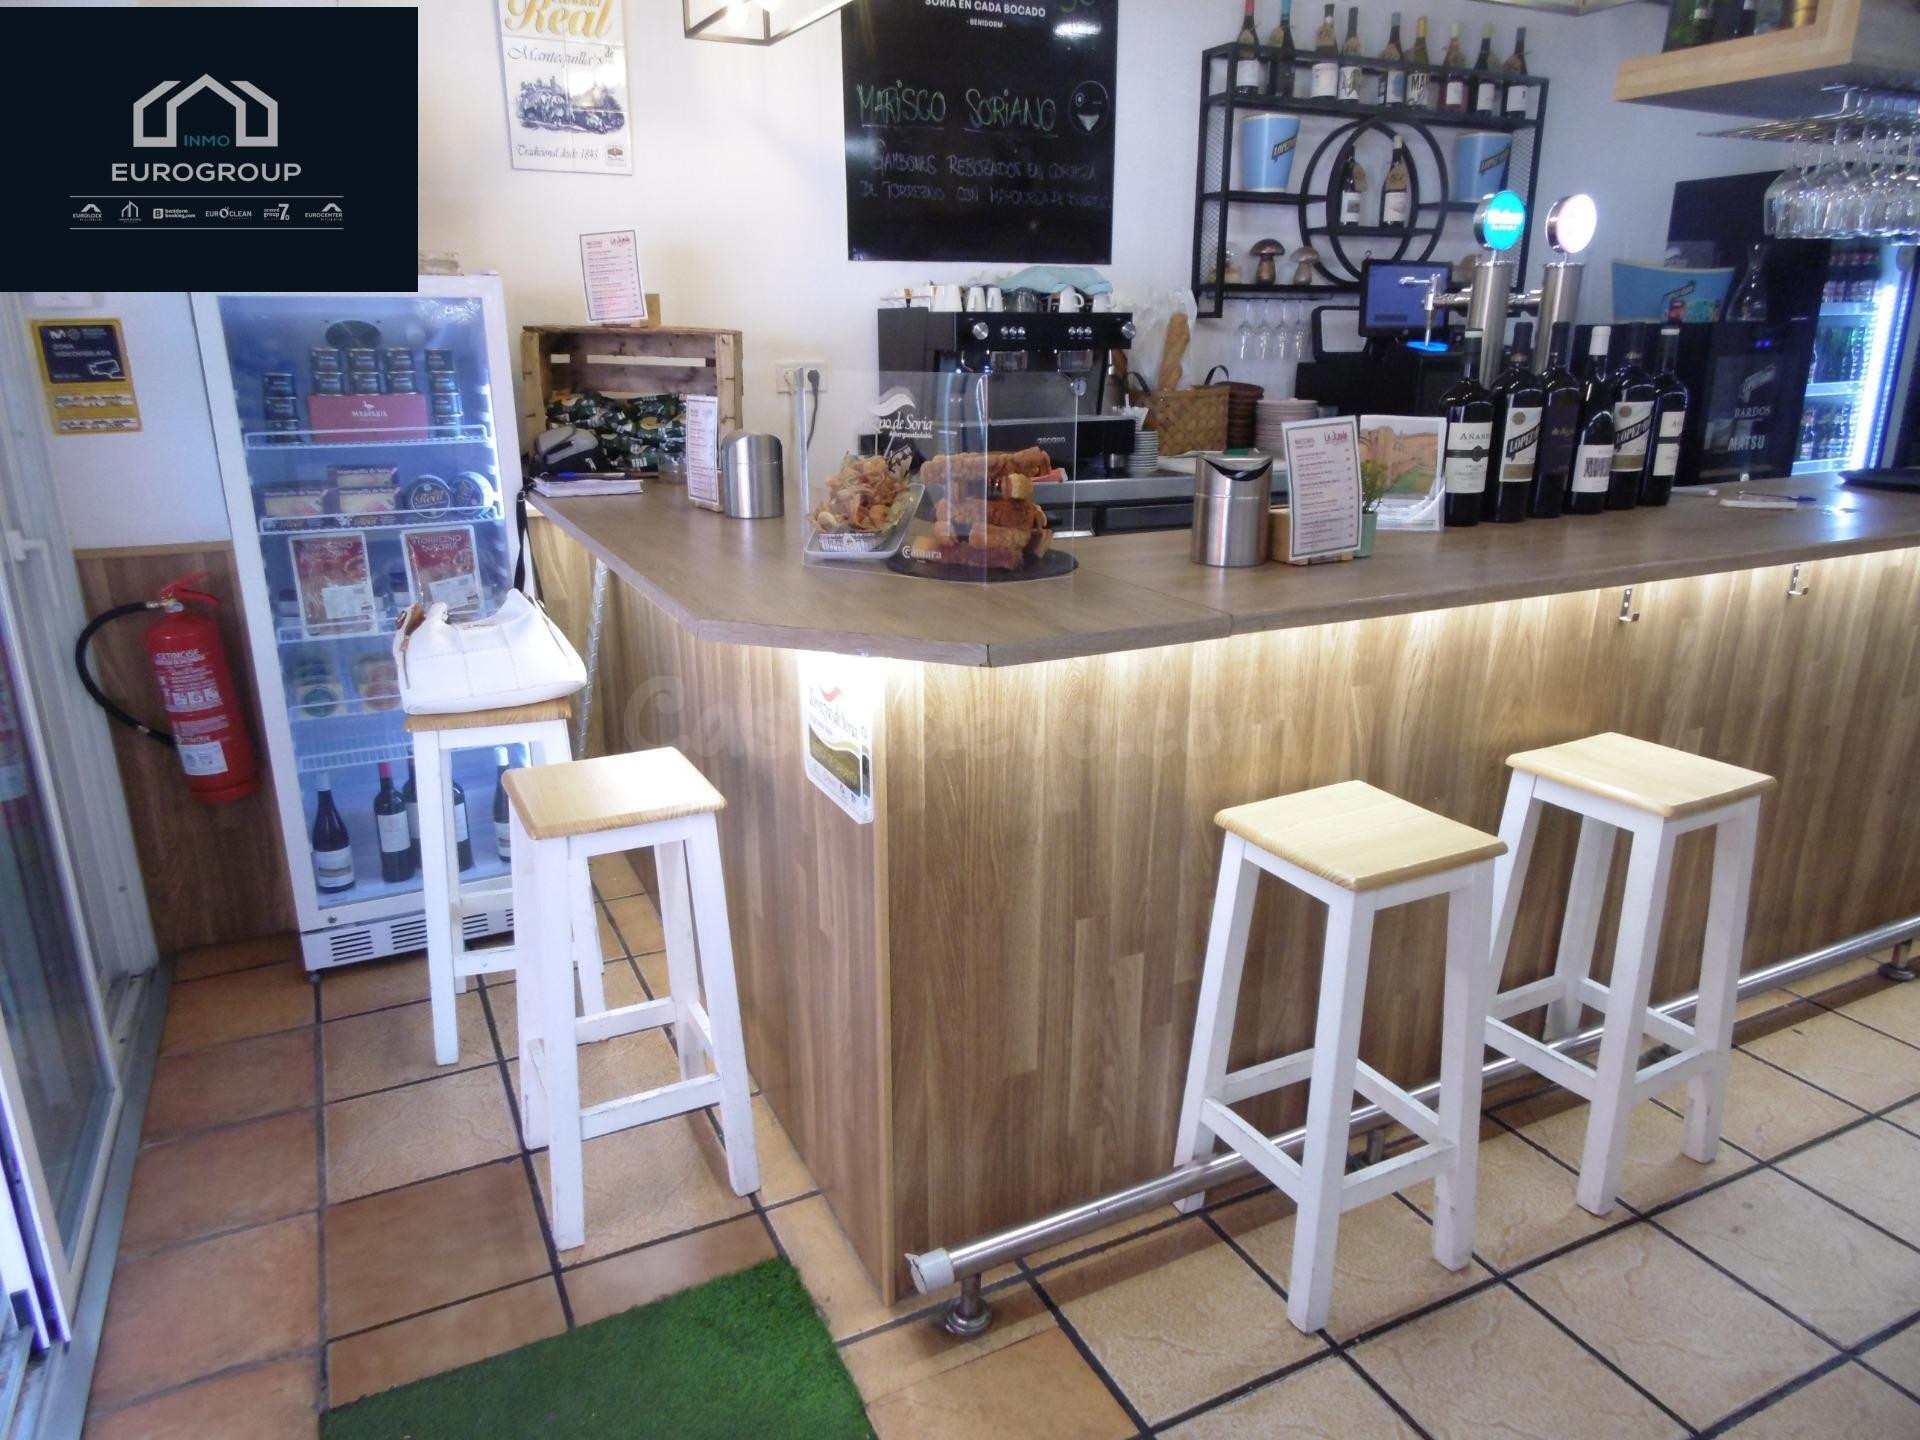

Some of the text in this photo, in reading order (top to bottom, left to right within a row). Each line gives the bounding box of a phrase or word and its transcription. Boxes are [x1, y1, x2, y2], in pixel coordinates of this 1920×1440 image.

[959, 0, 972, 10] EN
[974, 2, 1001, 13] CADA
[1004, 5, 1046, 17] BOCADO
[505, 0, 612, 38] Real
[969, 18, 1003, 28] BENIDORM
[905, 413, 933, 432] Soria
[1727, 434, 1766, 452] MATSU
